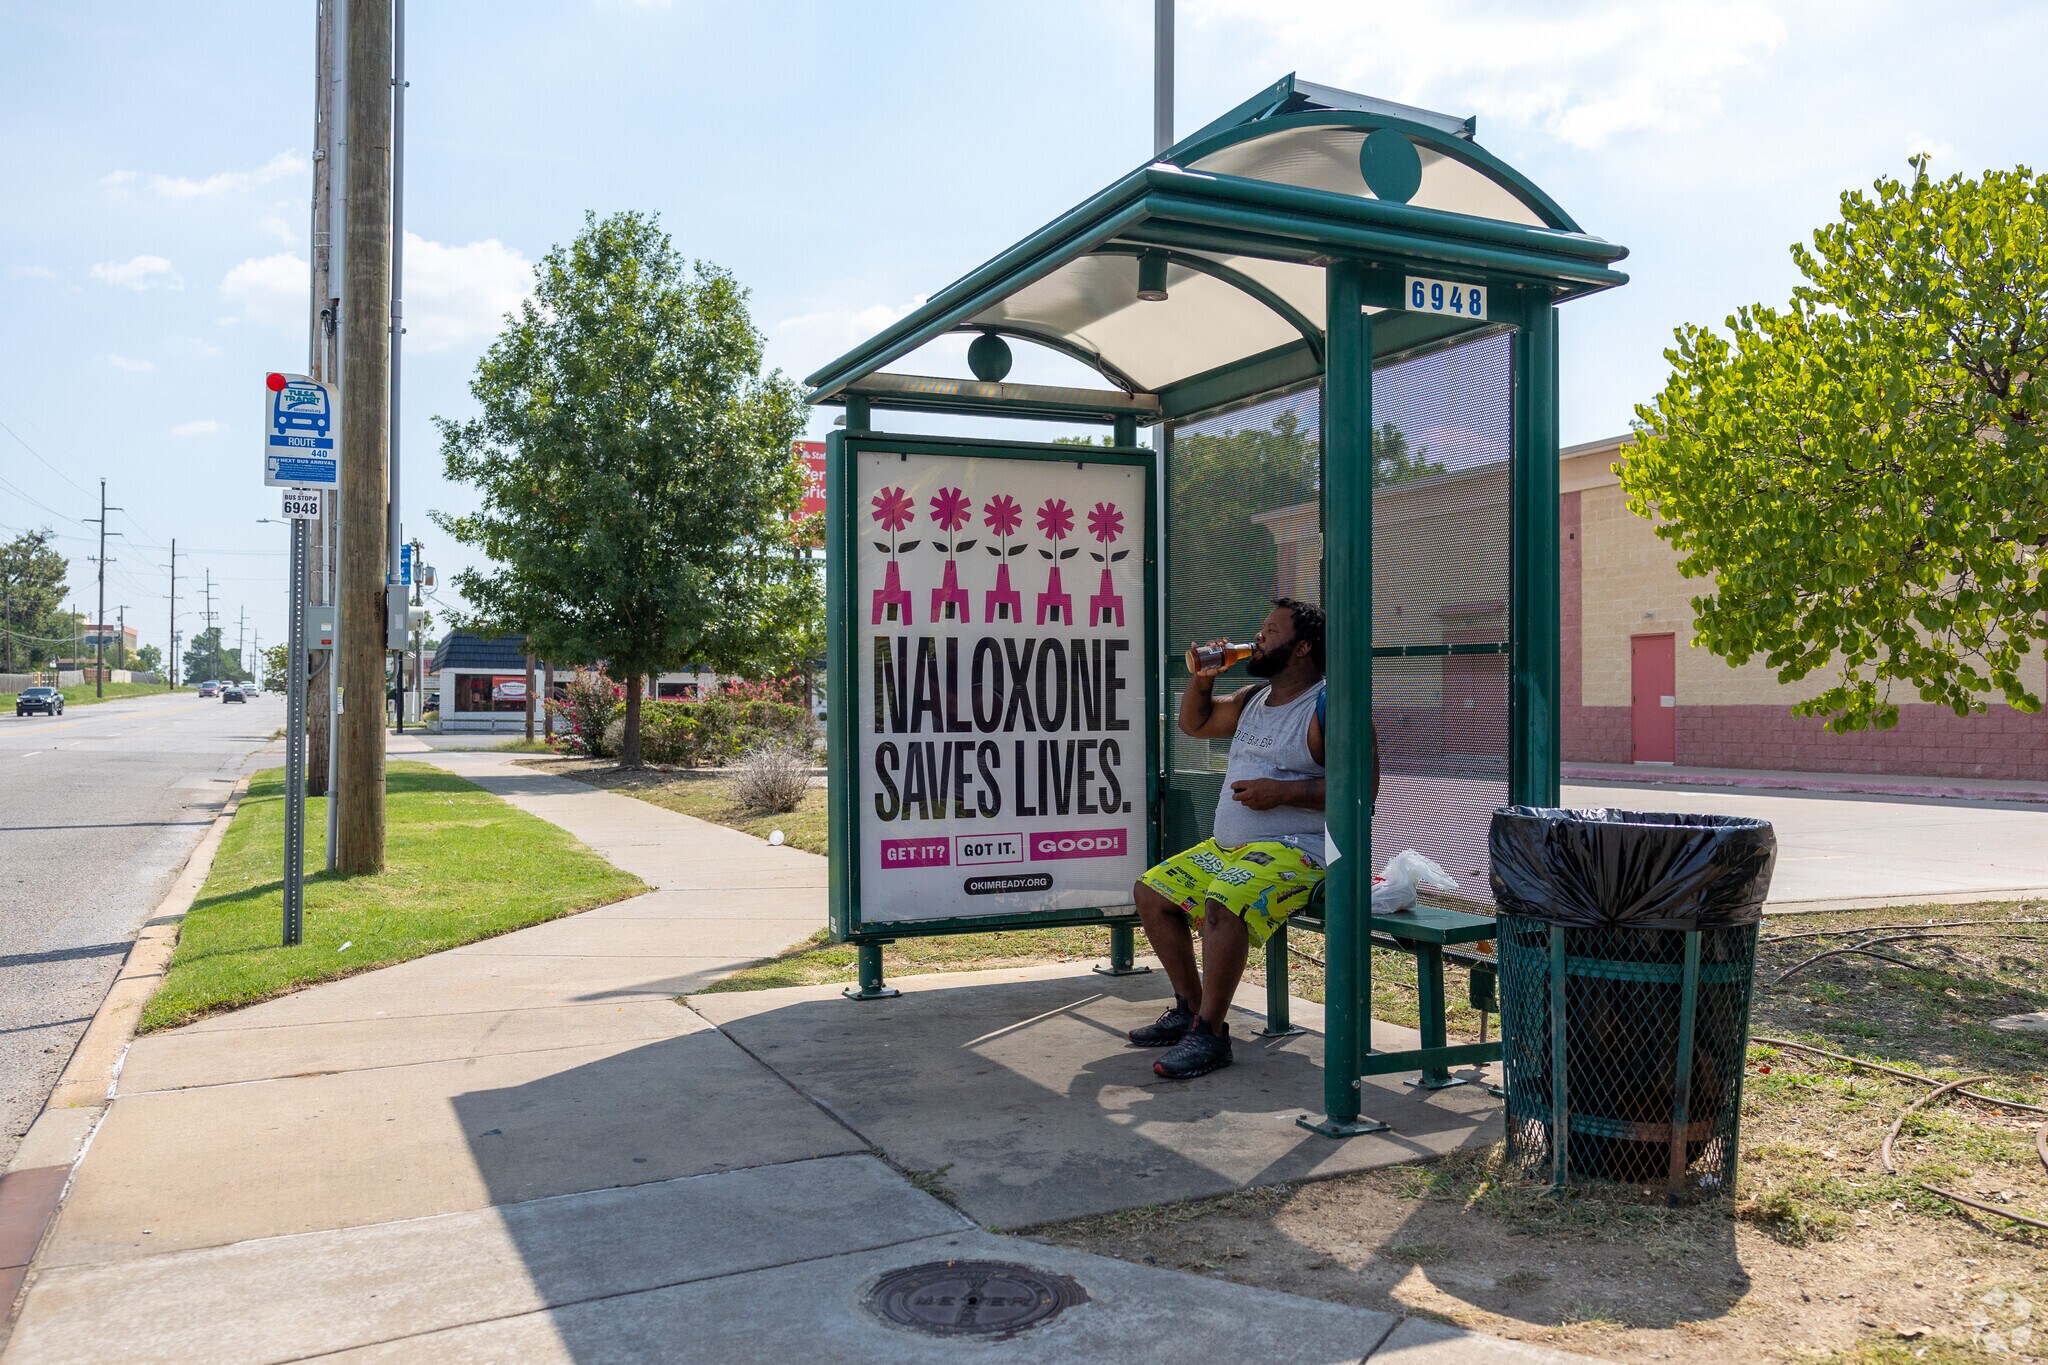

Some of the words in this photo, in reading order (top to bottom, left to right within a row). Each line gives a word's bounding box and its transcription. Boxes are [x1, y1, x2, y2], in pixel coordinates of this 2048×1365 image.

[1412, 281, 1481, 316] 6948
[284, 395, 320, 404] TRANSIT
[288, 389, 316, 397] TULSA
[288, 437, 316, 447] ROUTE
[311, 449, 328, 458] 440
[284, 502, 318, 515] 6948
[874, 636, 1130, 734] NALOXONE
[874, 739, 1002, 823] SAVES
[1015, 737, 1132, 817] LIVES.
[964, 843, 993, 857] GOT
[997, 842, 1016, 855] IT.
[1037, 836, 1119, 853] GOOD!
[887, 846, 916, 861] GET
[921, 845, 946, 860] IT?
[970, 878, 1047, 891] OKIMREADY.ORG
